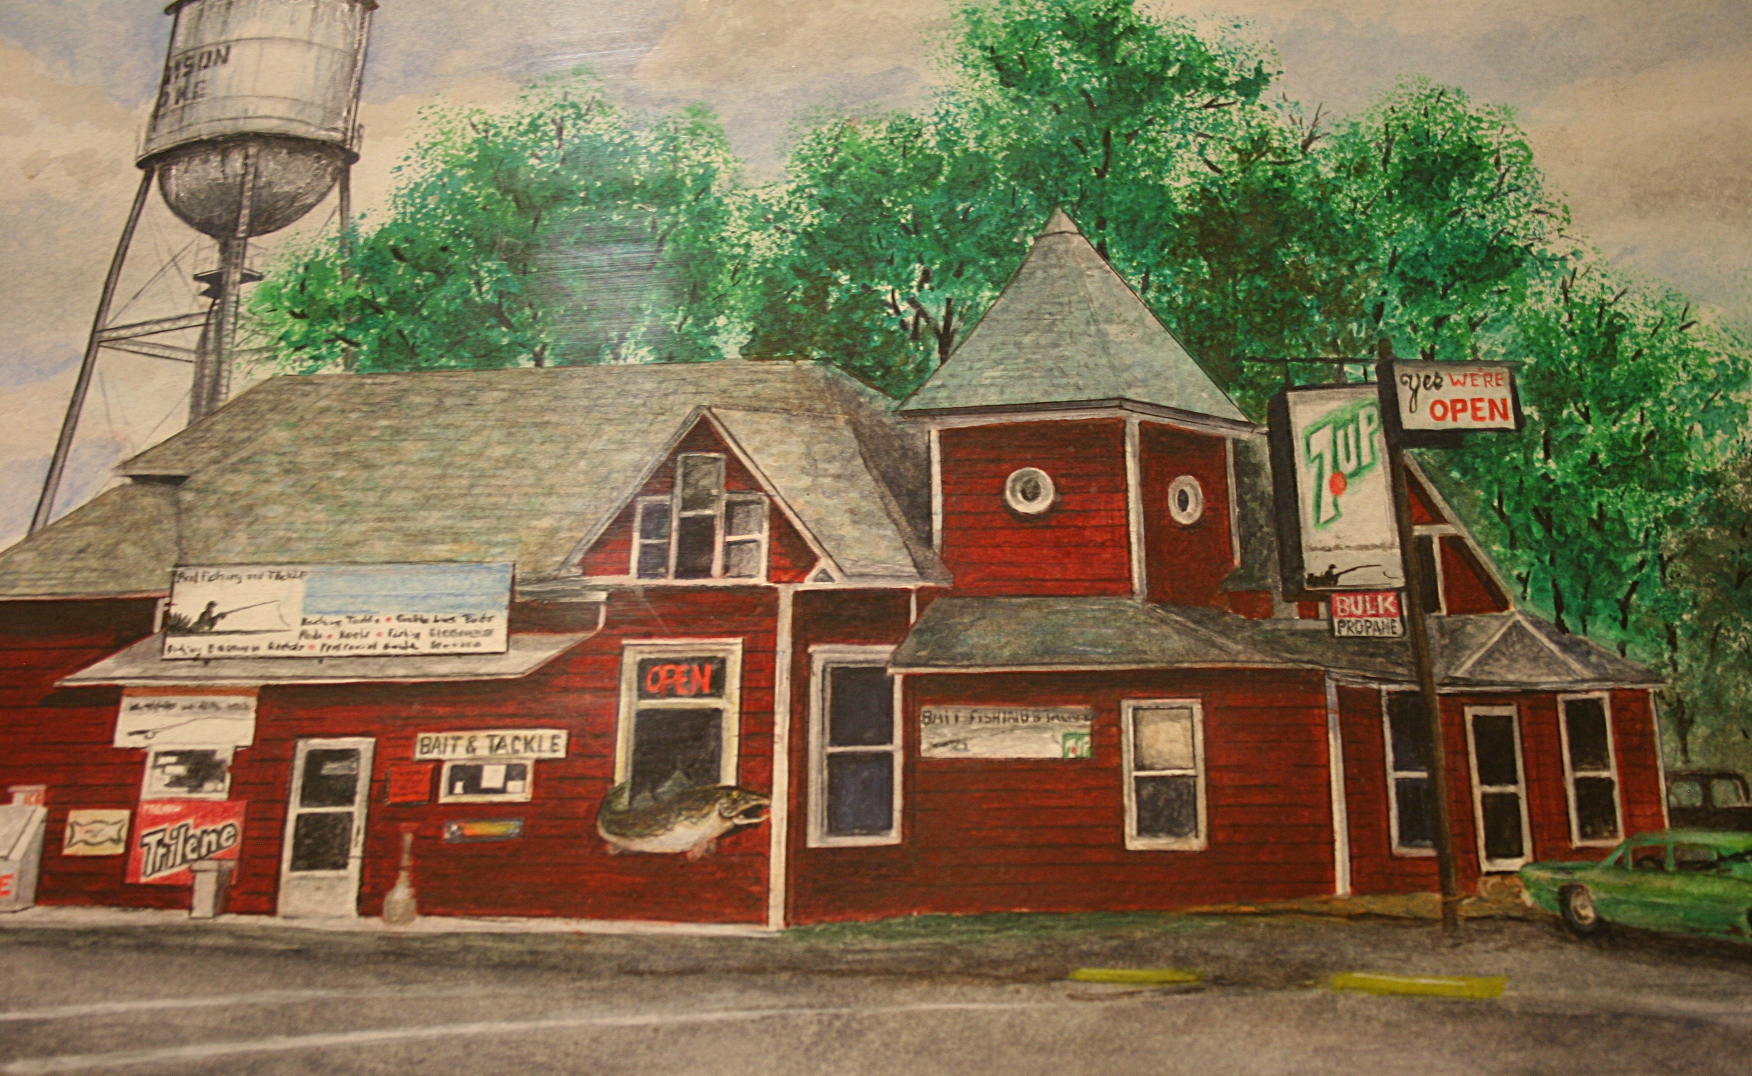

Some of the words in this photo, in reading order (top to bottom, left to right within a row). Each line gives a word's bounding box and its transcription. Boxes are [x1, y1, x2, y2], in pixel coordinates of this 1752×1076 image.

[1448, 368, 1504, 388] WE'RE
[1429, 397, 1510, 423] OPEN
[1303, 399, 1381, 528] 7UP
[1336, 592, 1398, 617] BULK
[1337, 618, 1398, 636] PROPANE
[646, 662, 712, 697] OPEN
[418, 735, 462, 755] BAIT
[464, 734, 478, 753] &
[485, 733, 562, 754] TACKLE
[139, 820, 239, 879] Trilene
